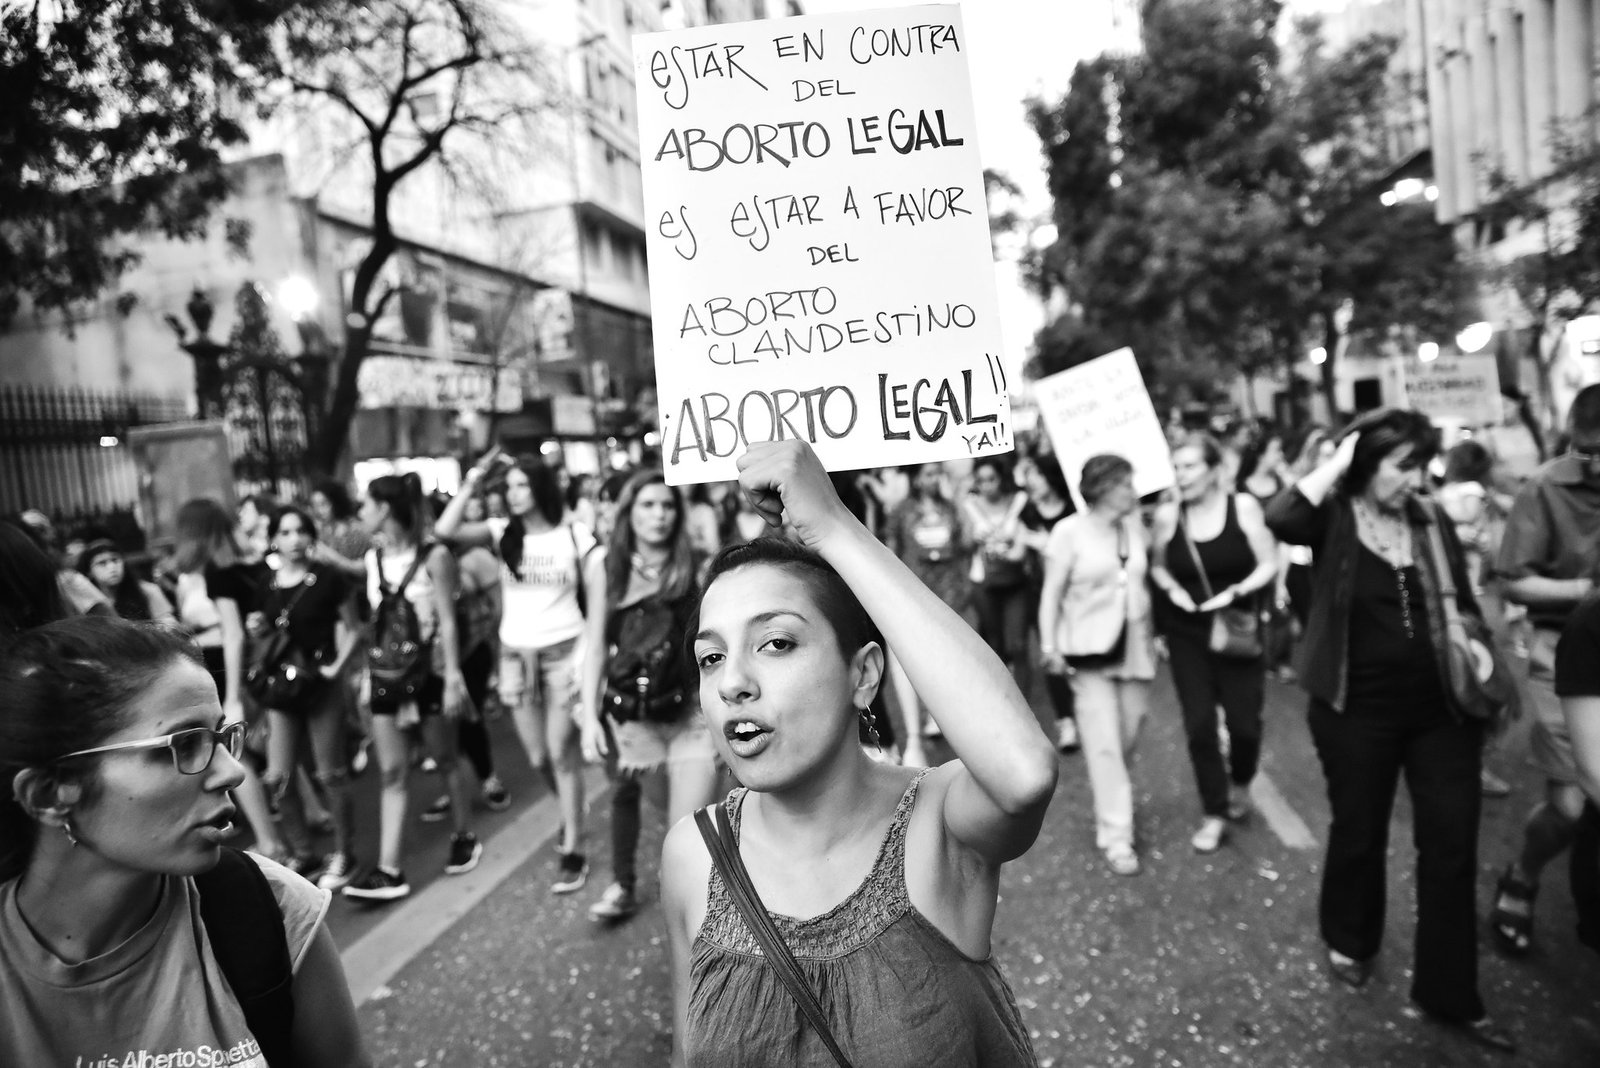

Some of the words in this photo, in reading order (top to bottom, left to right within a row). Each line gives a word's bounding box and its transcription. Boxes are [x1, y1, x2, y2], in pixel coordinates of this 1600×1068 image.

[772, 28, 824, 63] EN
[849, 24, 961, 65] CONTRA
[791, 79, 856, 103] DEL
[654, 120, 831, 172] ABORTO
[846, 108, 964, 157] LEGAL
[842, 185, 861, 220] A
[873, 185, 973, 227] FAVOR
[806, 242, 860, 267] DEL
[679, 286, 837, 339] ABORTO
[961, 422, 1010, 455] YA!!
[121, 1048, 196, 1068] Alberto
